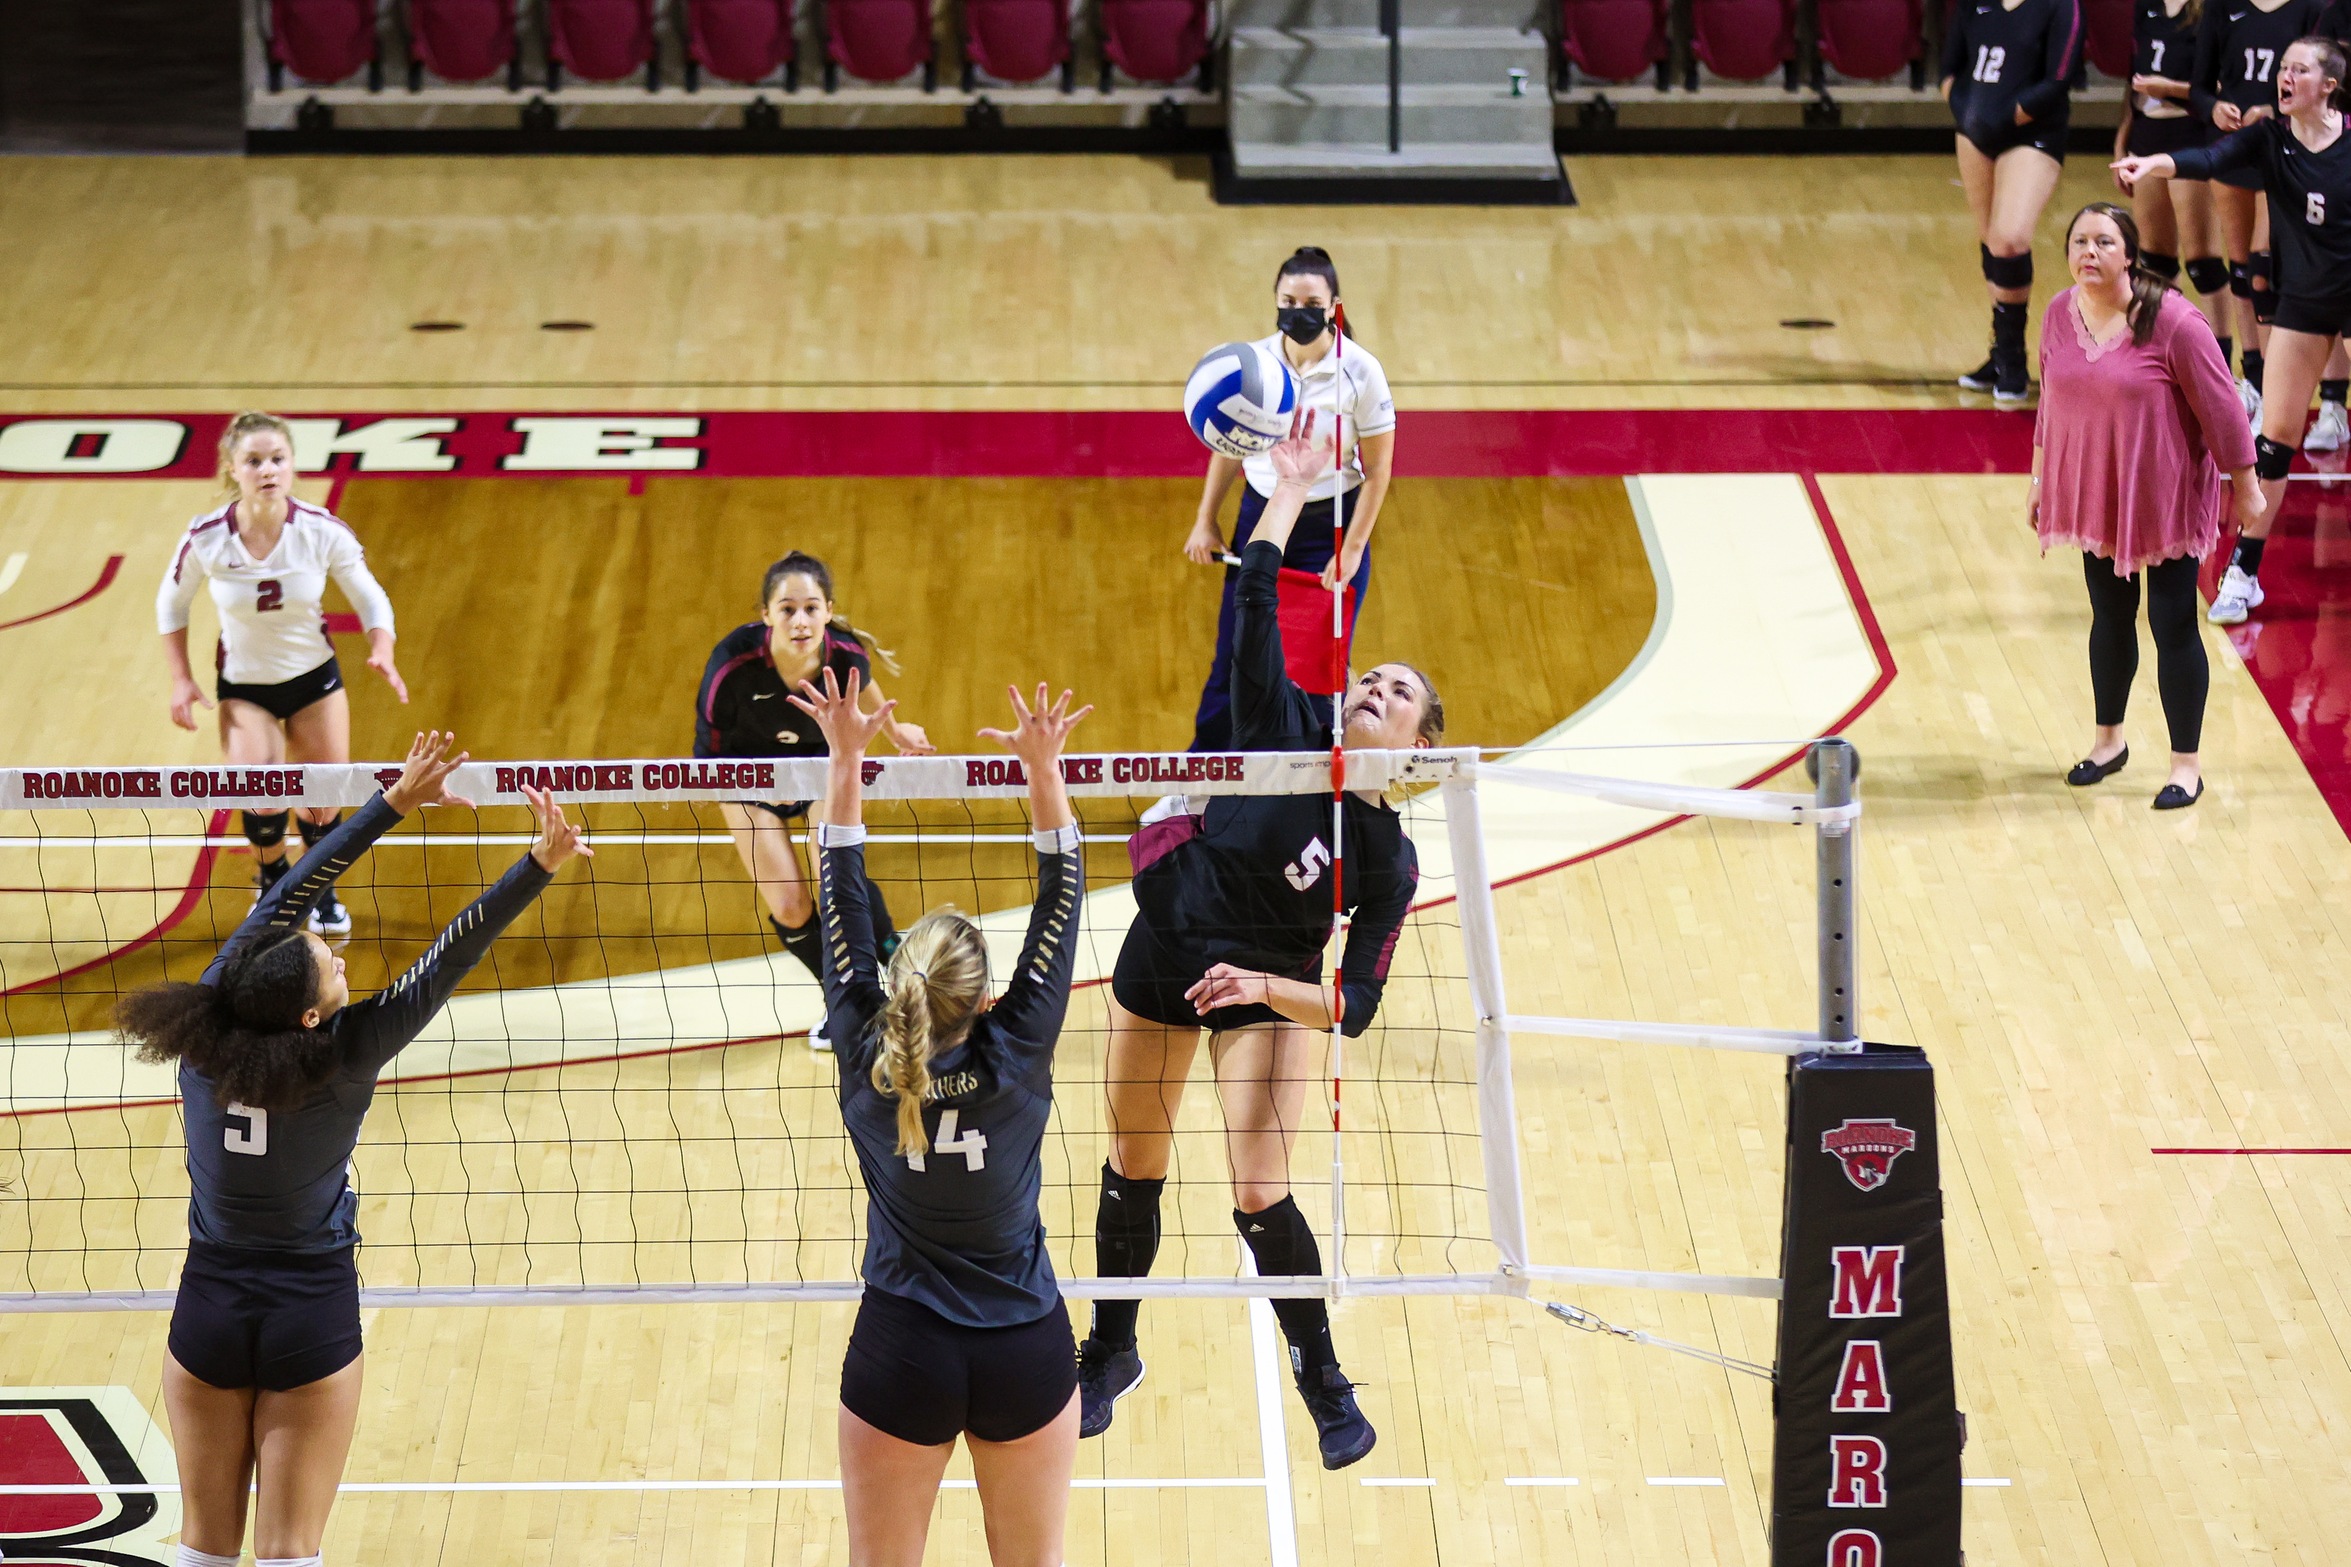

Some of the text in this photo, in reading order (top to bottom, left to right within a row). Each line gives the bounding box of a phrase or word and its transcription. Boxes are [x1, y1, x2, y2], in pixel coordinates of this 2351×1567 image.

[1973, 44, 2006, 83] 12
[2151, 39, 2166, 72] 7
[2244, 48, 2275, 82] 17
[2305, 192, 2326, 226] 6
[256, 580, 284, 613] 2
[23, 770, 304, 799] ROANOKE COLLEGE
[496, 763, 775, 793] ROANOKE COLLEGE
[966, 755, 1244, 787] ROAKE COLLEGE
[1284, 836, 1330, 891] 5
